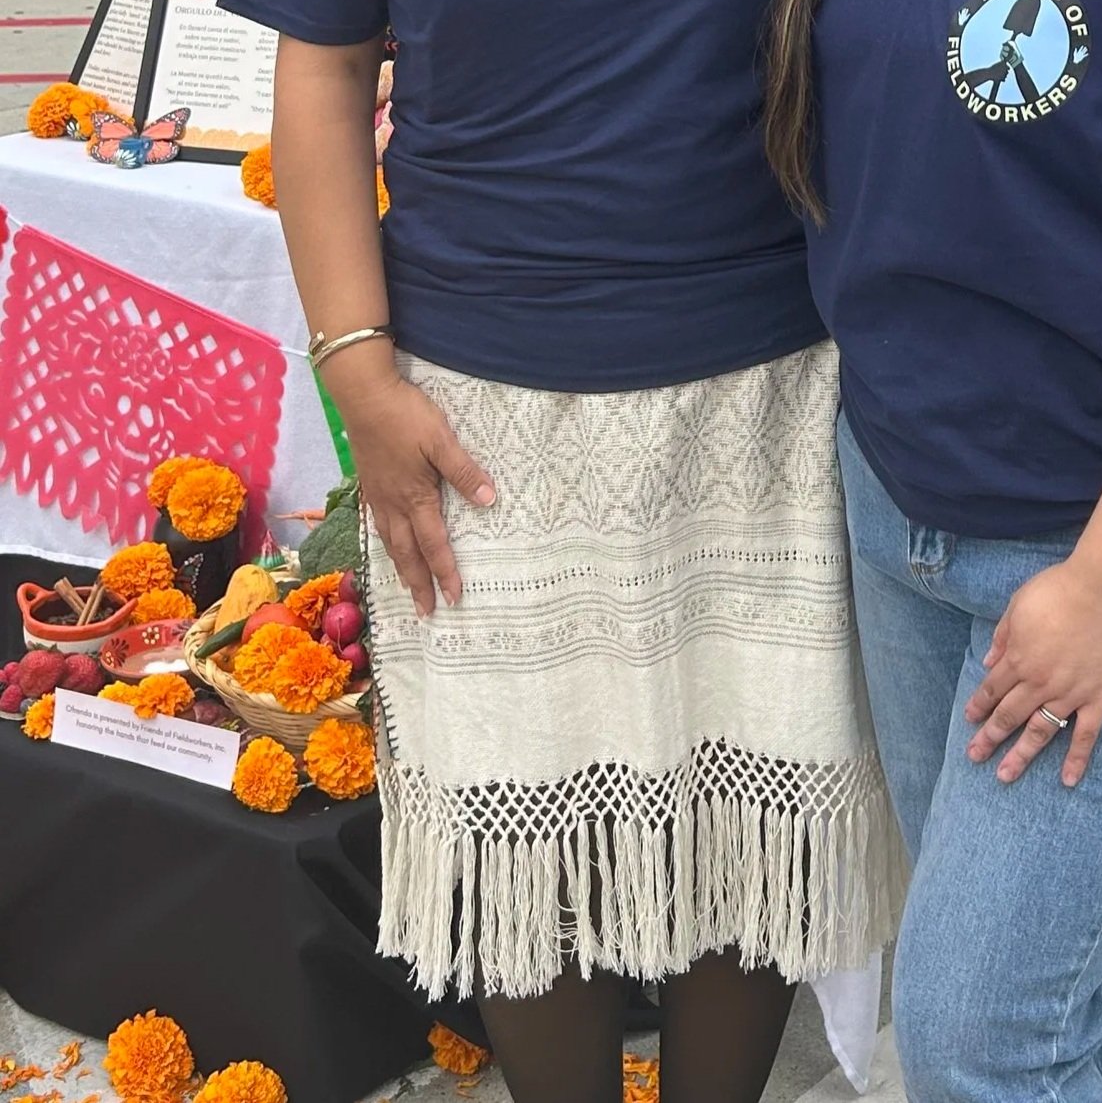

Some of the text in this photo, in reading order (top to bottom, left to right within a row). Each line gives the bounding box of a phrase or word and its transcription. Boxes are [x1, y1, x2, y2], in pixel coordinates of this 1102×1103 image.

[175, 5, 212, 16] ORGULLO
[1065, 5, 1088, 37] OF
[946, 37, 1077, 122] FIELDWORKERS
[76, 719, 103, 735] honoring
[116, 728, 135, 741] hands
[150, 738, 165, 749] feed
[99, 714, 131, 729] presented
[141, 723, 163, 736] Friends
